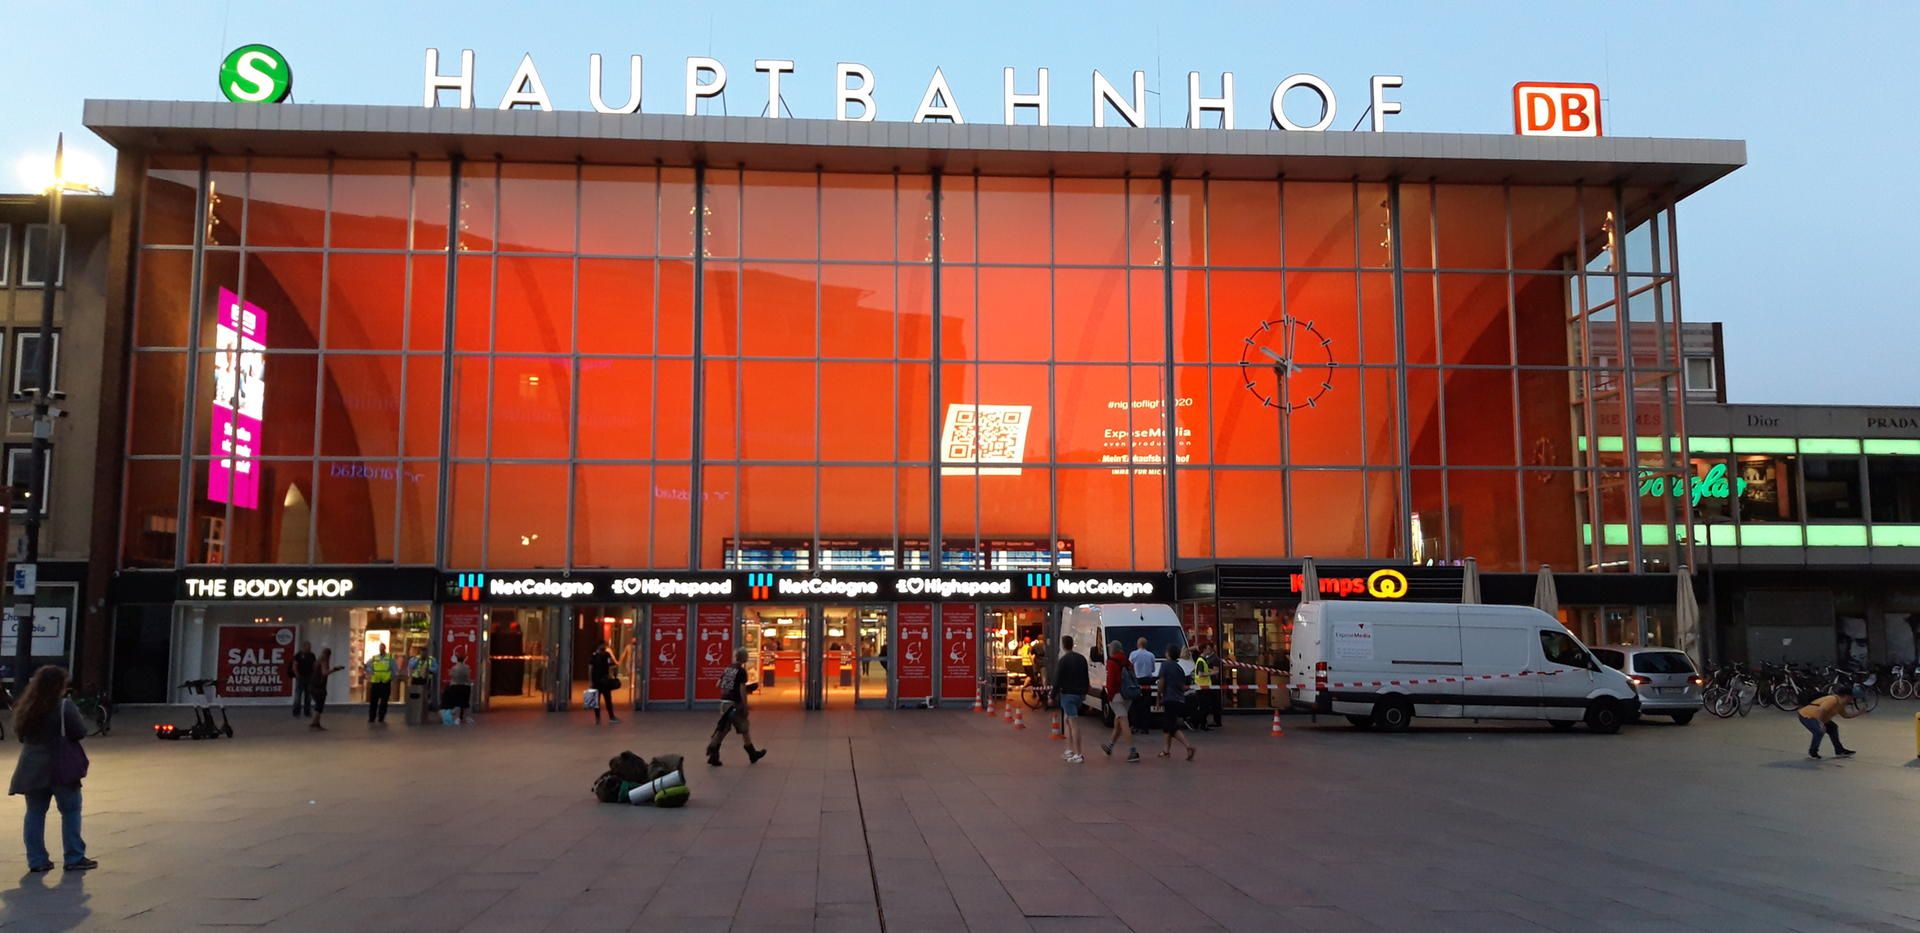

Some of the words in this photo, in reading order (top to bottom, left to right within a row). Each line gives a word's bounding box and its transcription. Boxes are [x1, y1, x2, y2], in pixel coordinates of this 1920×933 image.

[230, 51, 278, 102] S
[424, 48, 1403, 133] HAUPTBAHNHOF
[1526, 92, 1590, 131] DB
[1747, 415, 1780, 427] Dior
[1867, 417, 1918, 428] PRADA
[185, 578, 227, 597] THE
[233, 578, 293, 597] BODY
[296, 578, 353, 597] SHOP
[490, 578, 595, 598] NetCologne
[642, 578, 733, 598] Highspeed
[779, 578, 878, 597] NetCologne
[924, 577, 1011, 597] Highspeed
[1057, 578, 1154, 597] NetCologne
[1290, 573, 1366, 597] Kmps
[228, 647, 285, 665] SALE
[226, 675, 283, 685] AUSWAHL
[232, 665, 279, 676] GROSSE
